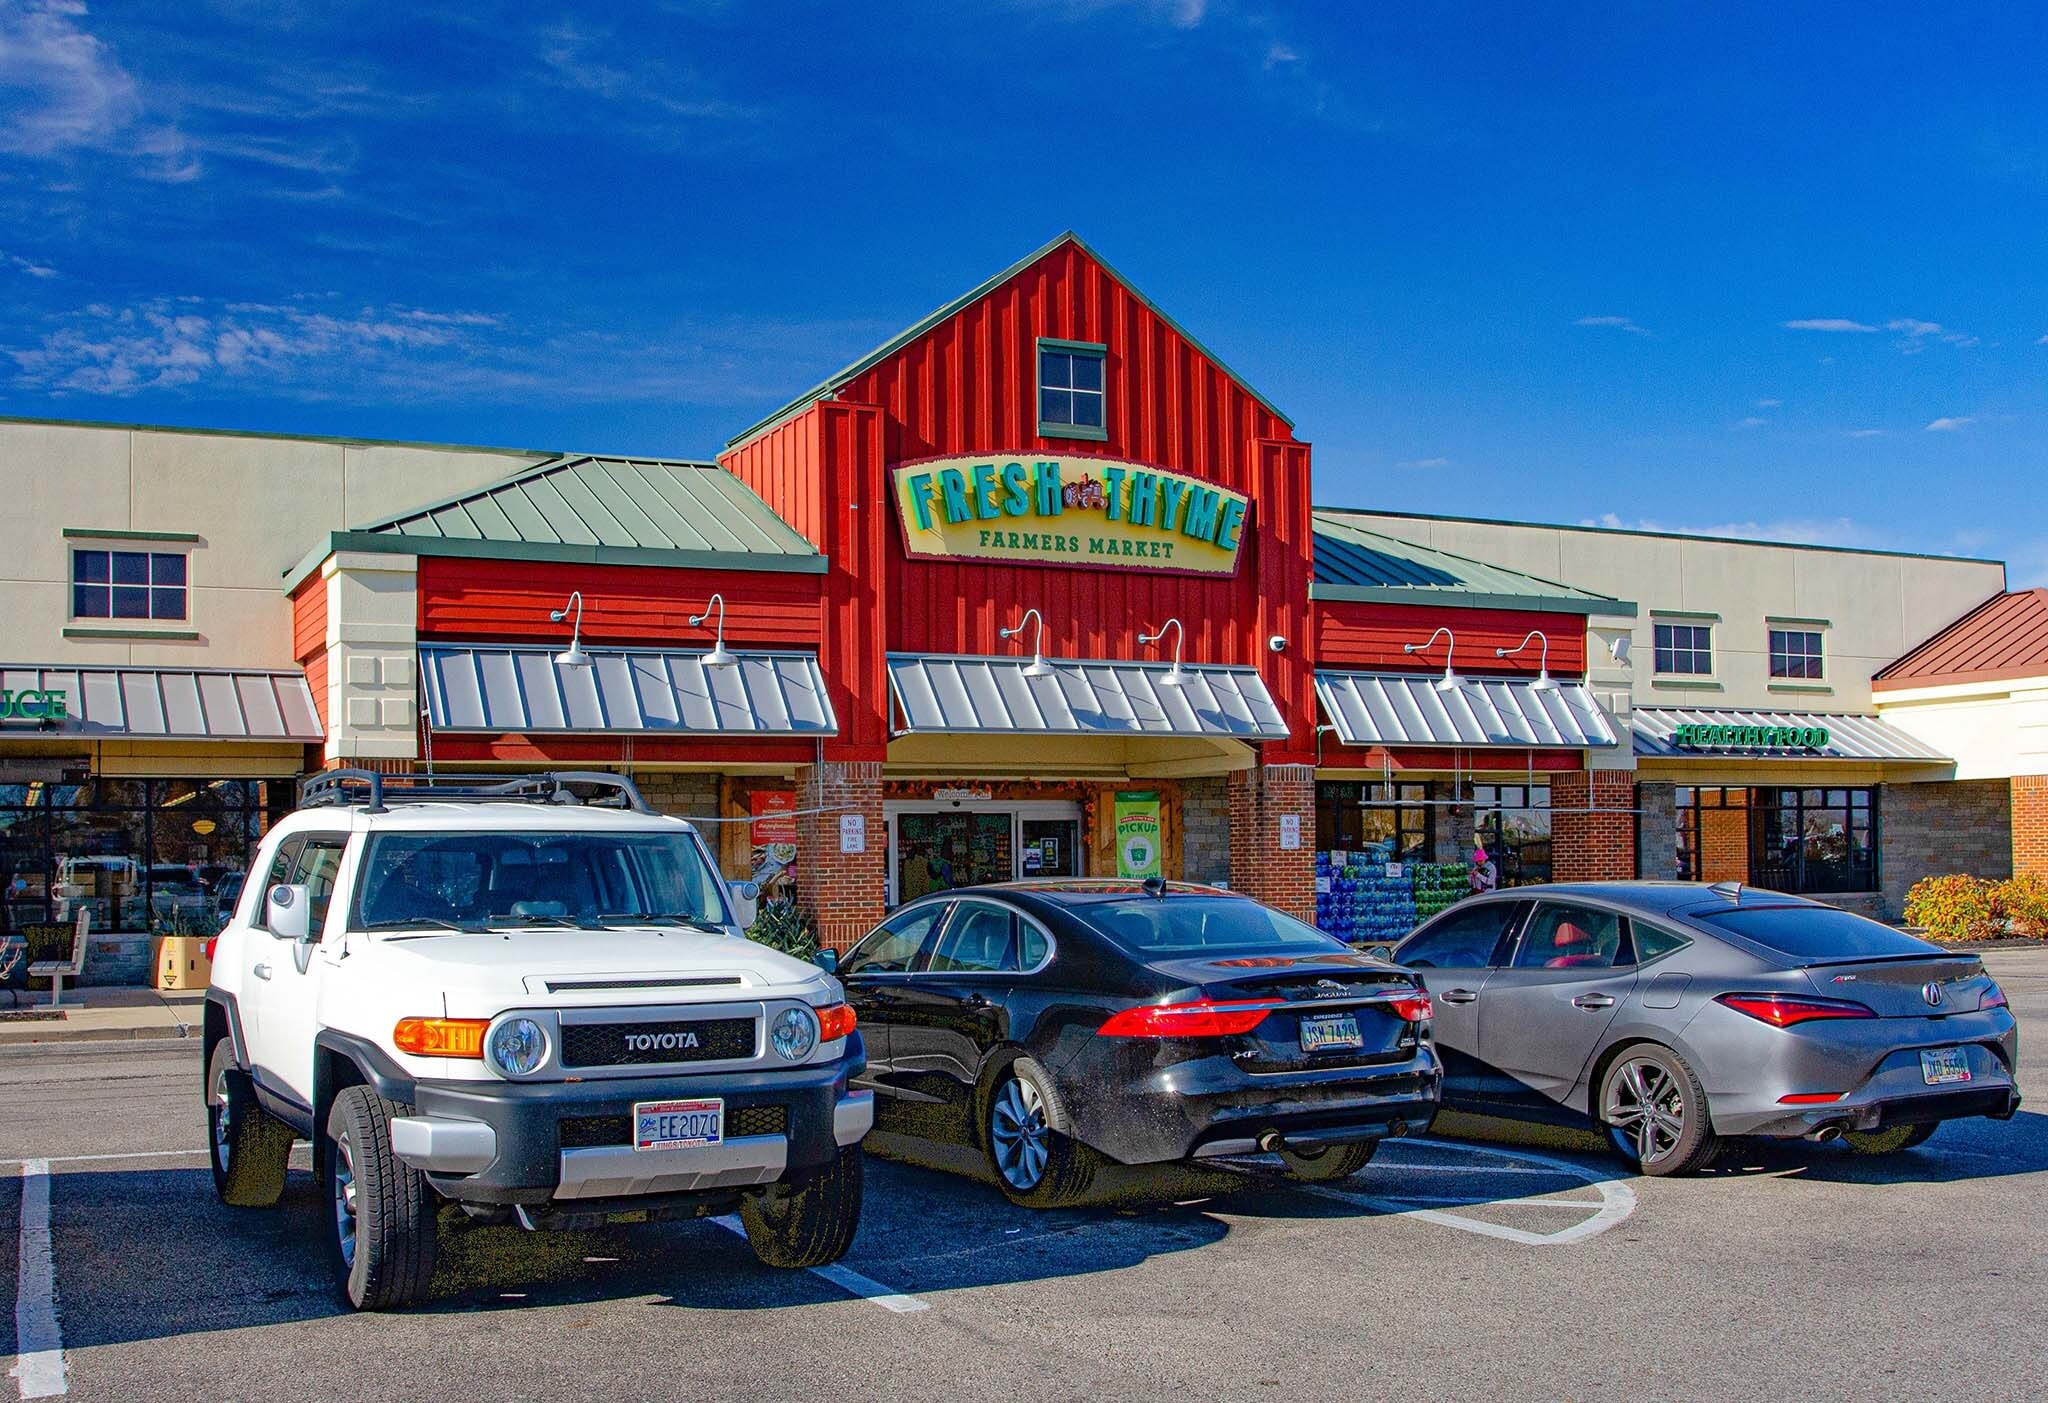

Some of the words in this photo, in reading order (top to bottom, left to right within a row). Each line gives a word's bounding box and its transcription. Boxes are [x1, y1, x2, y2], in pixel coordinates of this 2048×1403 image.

[908, 461, 1063, 531] FRESH
[1103, 466, 1246, 551] THYME
[979, 530, 1080, 552] FARMERS
[1088, 538, 1174, 559] MARKET
[1676, 724, 1772, 746] HEALTHY
[1773, 727, 1829, 747] FOOD
[847, 818, 857, 827] NO
[1118, 821, 1158, 835] PICKUP
[625, 1033, 698, 1050] TOYOTA
[1233, 1050, 1258, 1059] XF
